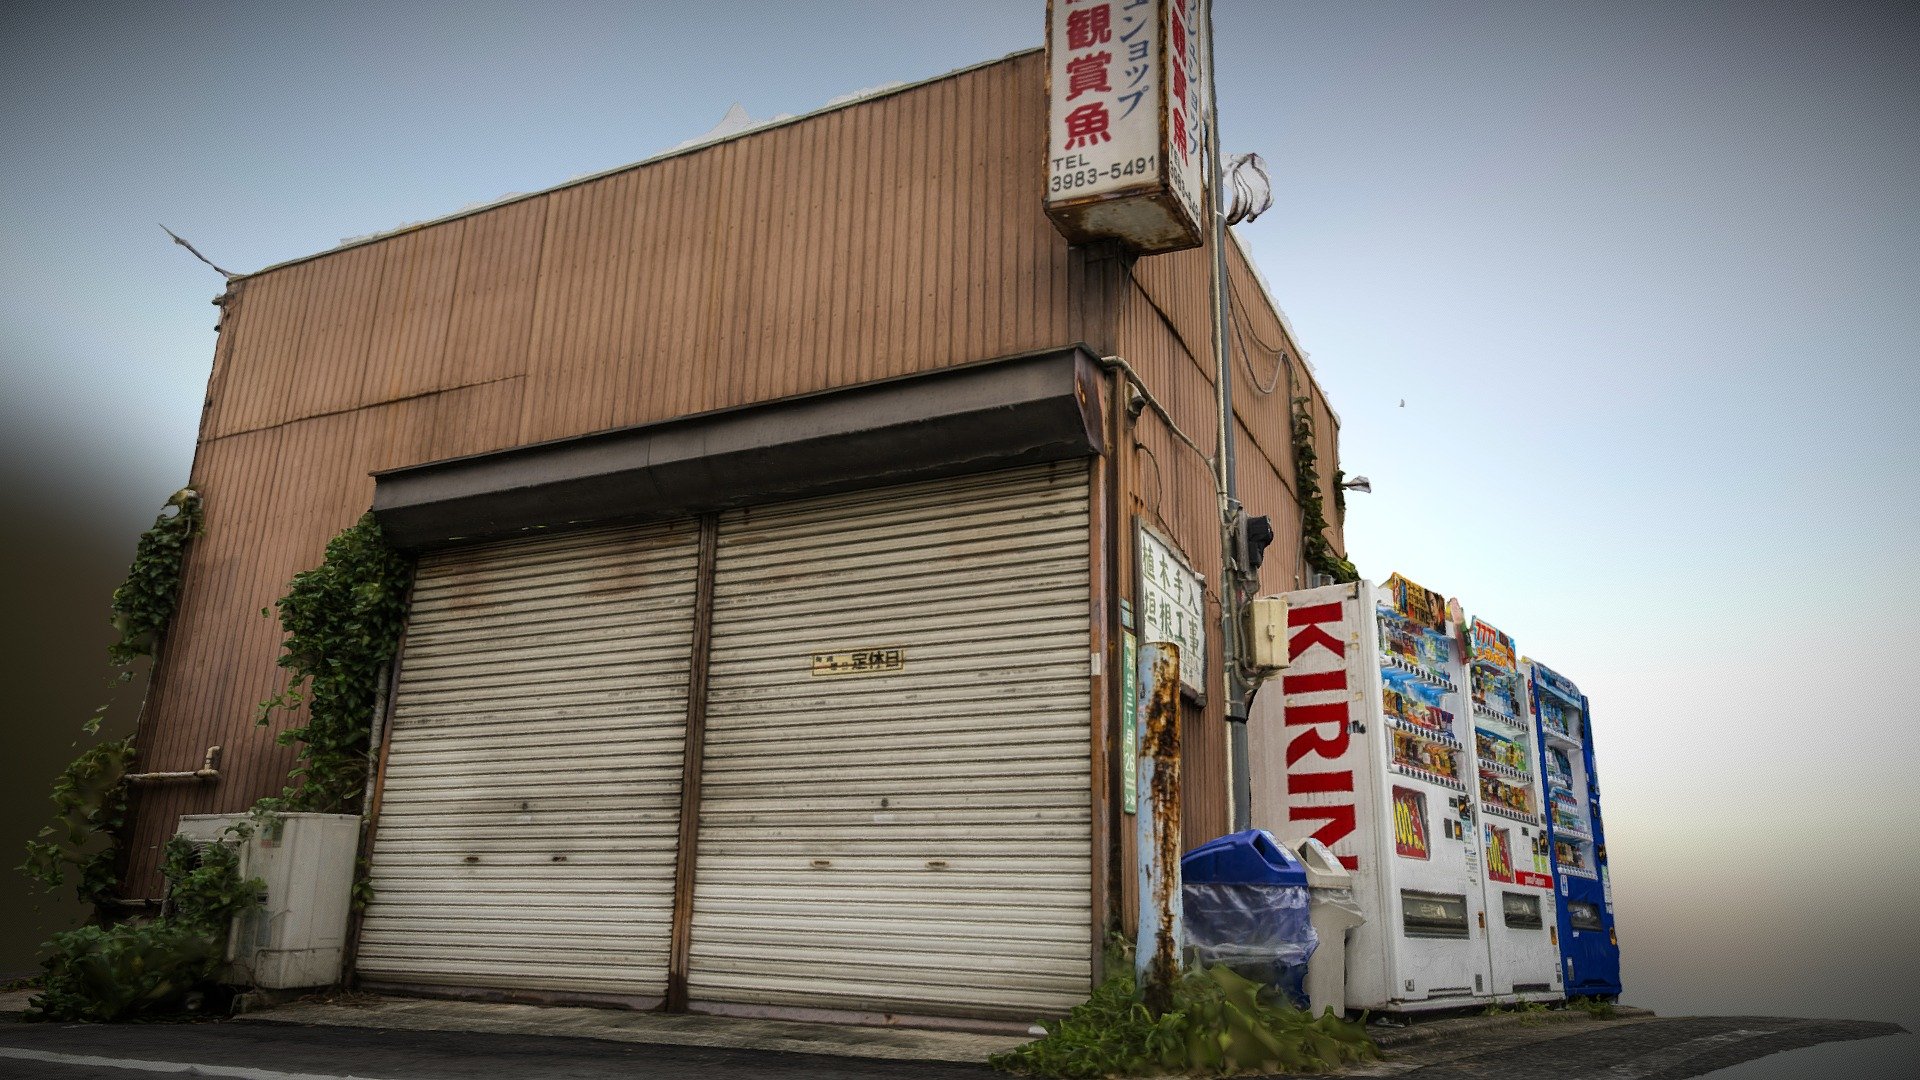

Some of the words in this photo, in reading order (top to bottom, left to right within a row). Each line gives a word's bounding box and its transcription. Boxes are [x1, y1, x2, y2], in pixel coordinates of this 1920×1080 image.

[1064, 0, 1113, 150] 観賞魚
[1051, 155, 1156, 192] 3983-5491
[1052, 154, 1090, 171] TEL
[1142, 535, 1200, 616] 植木手入
[1144, 587, 1200, 657] 垣根工事
[1282, 601, 1359, 871] KIRIN
